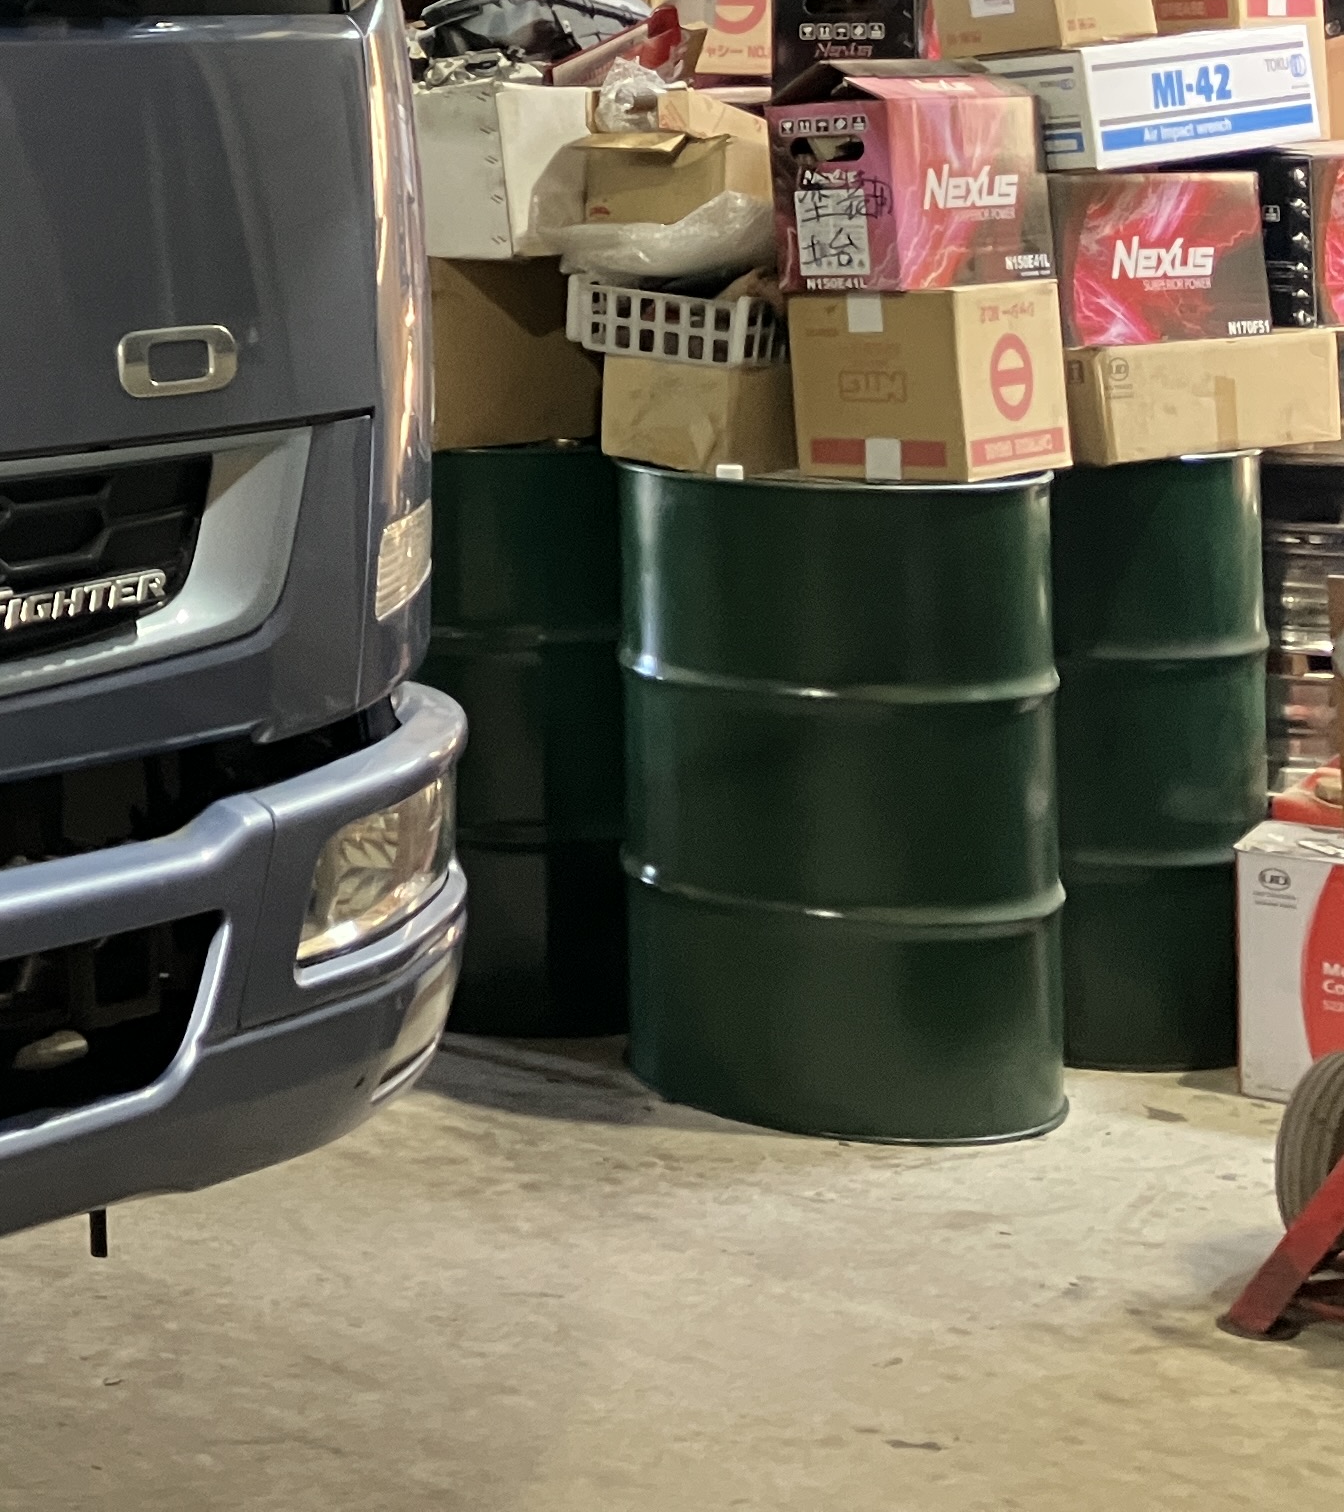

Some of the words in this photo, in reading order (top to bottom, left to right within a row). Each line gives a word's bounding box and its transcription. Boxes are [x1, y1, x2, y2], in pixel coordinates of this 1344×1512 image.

[1151, 63, 1233, 110] MI-42
[1143, 126, 1158, 143] Air
[1161, 121, 1194, 142] Impact
[1196, 117, 1233, 136] wrench
